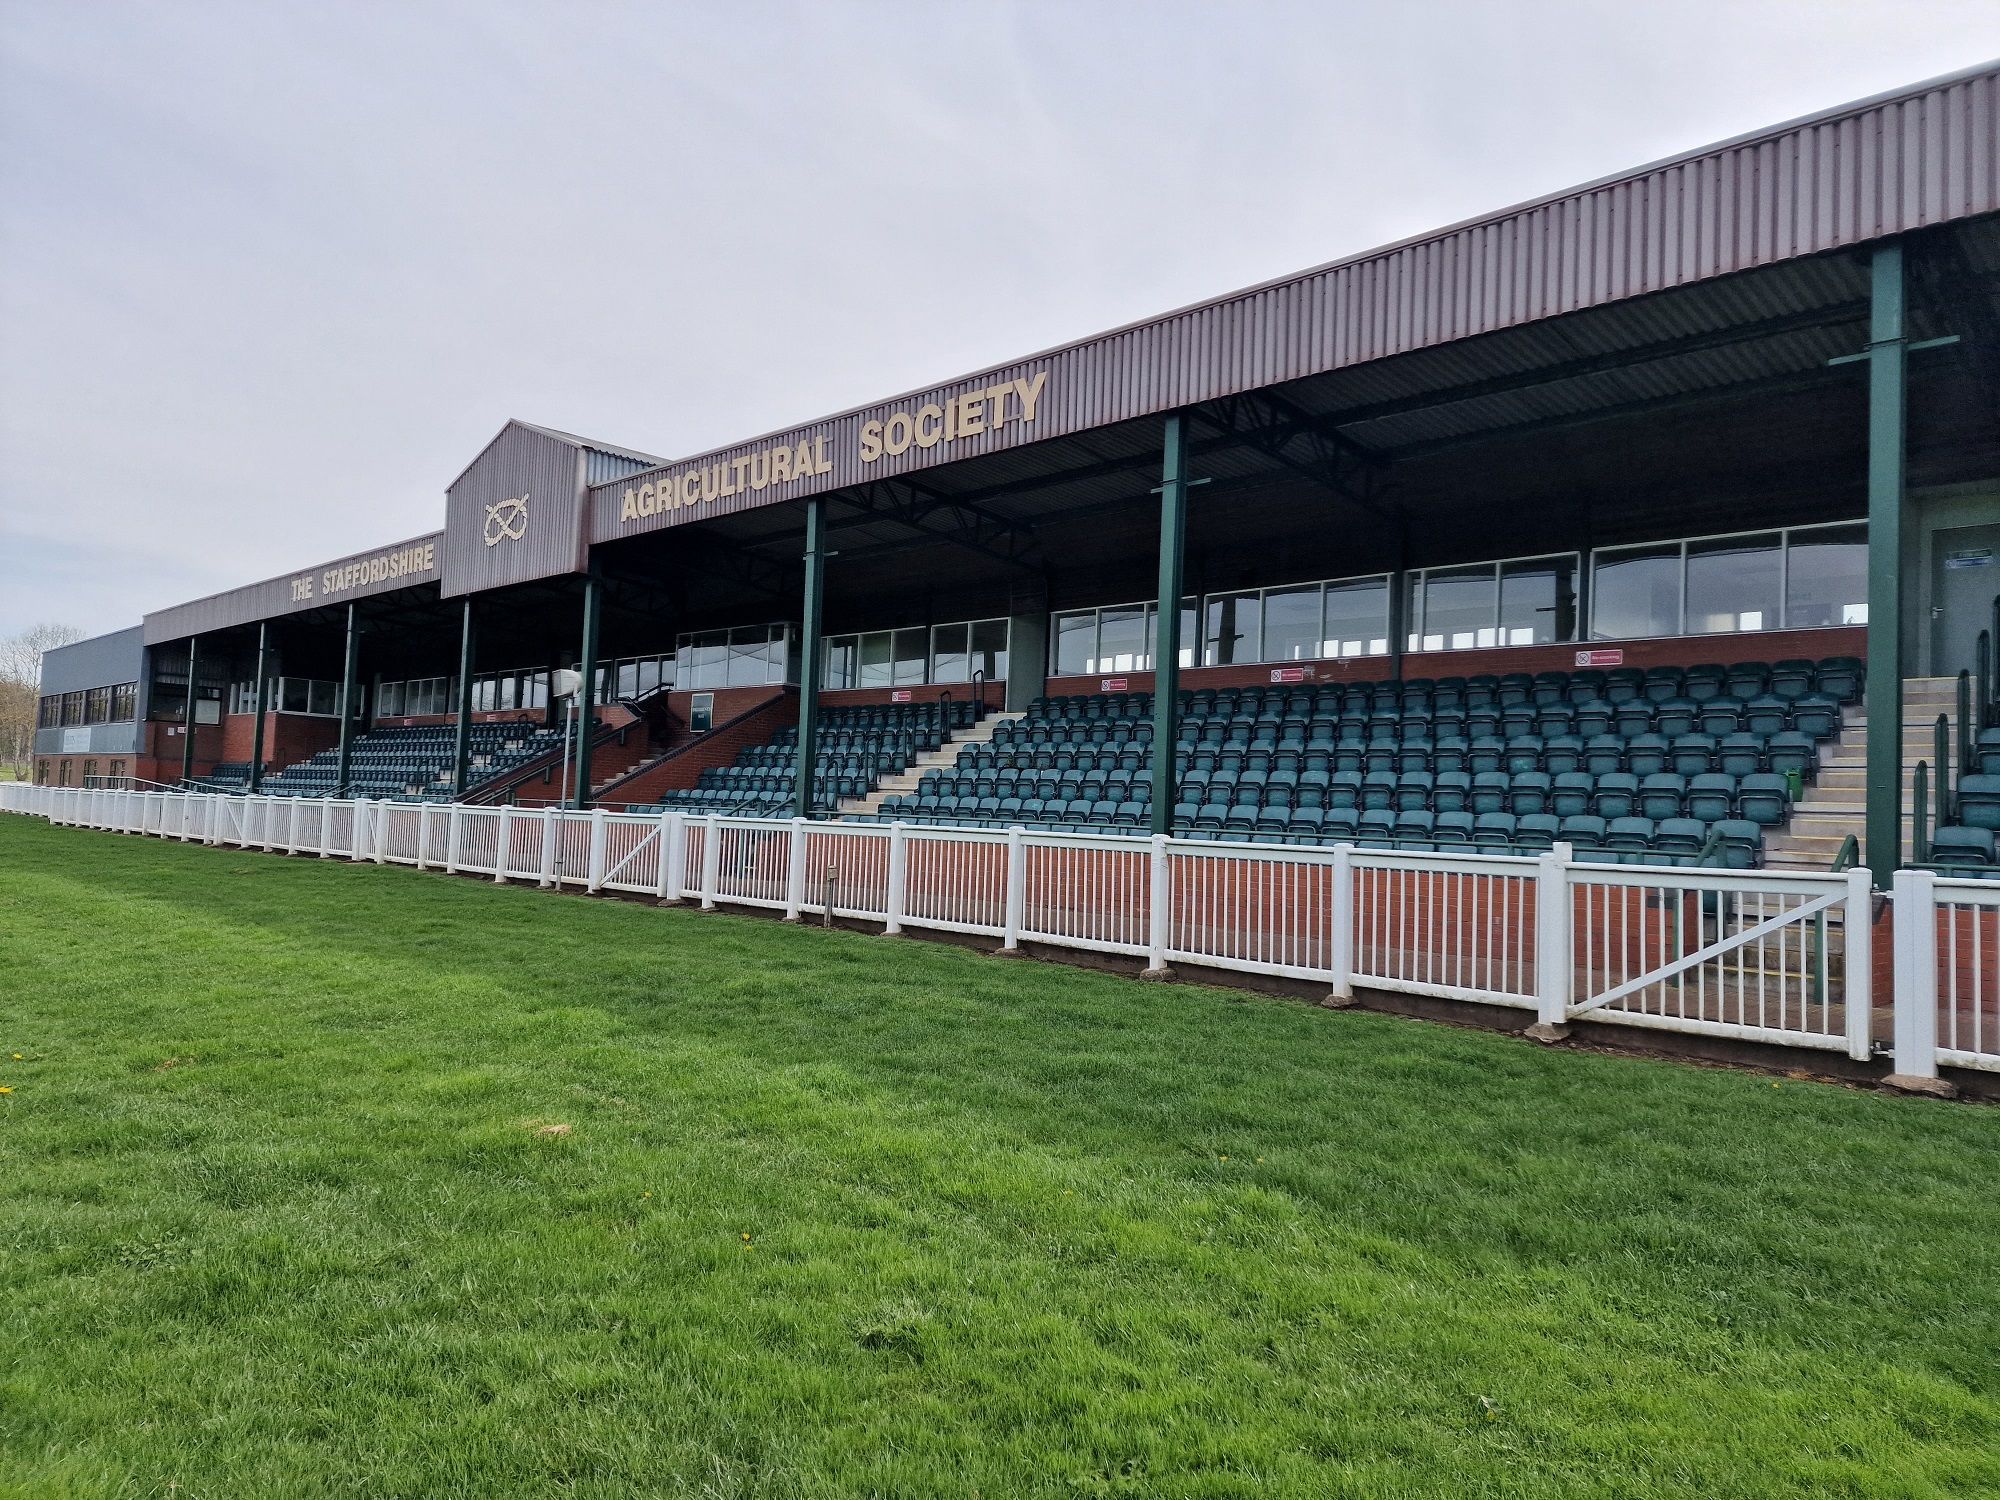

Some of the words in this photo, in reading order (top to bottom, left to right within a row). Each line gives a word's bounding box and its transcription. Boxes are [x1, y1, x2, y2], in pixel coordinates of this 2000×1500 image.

[620, 435, 832, 522] AGRICULTURAL
[860, 372, 1047, 463] SOCIETY
[291, 576, 313, 601] THE
[323, 543, 434, 595] STAFFORDSHIRE
